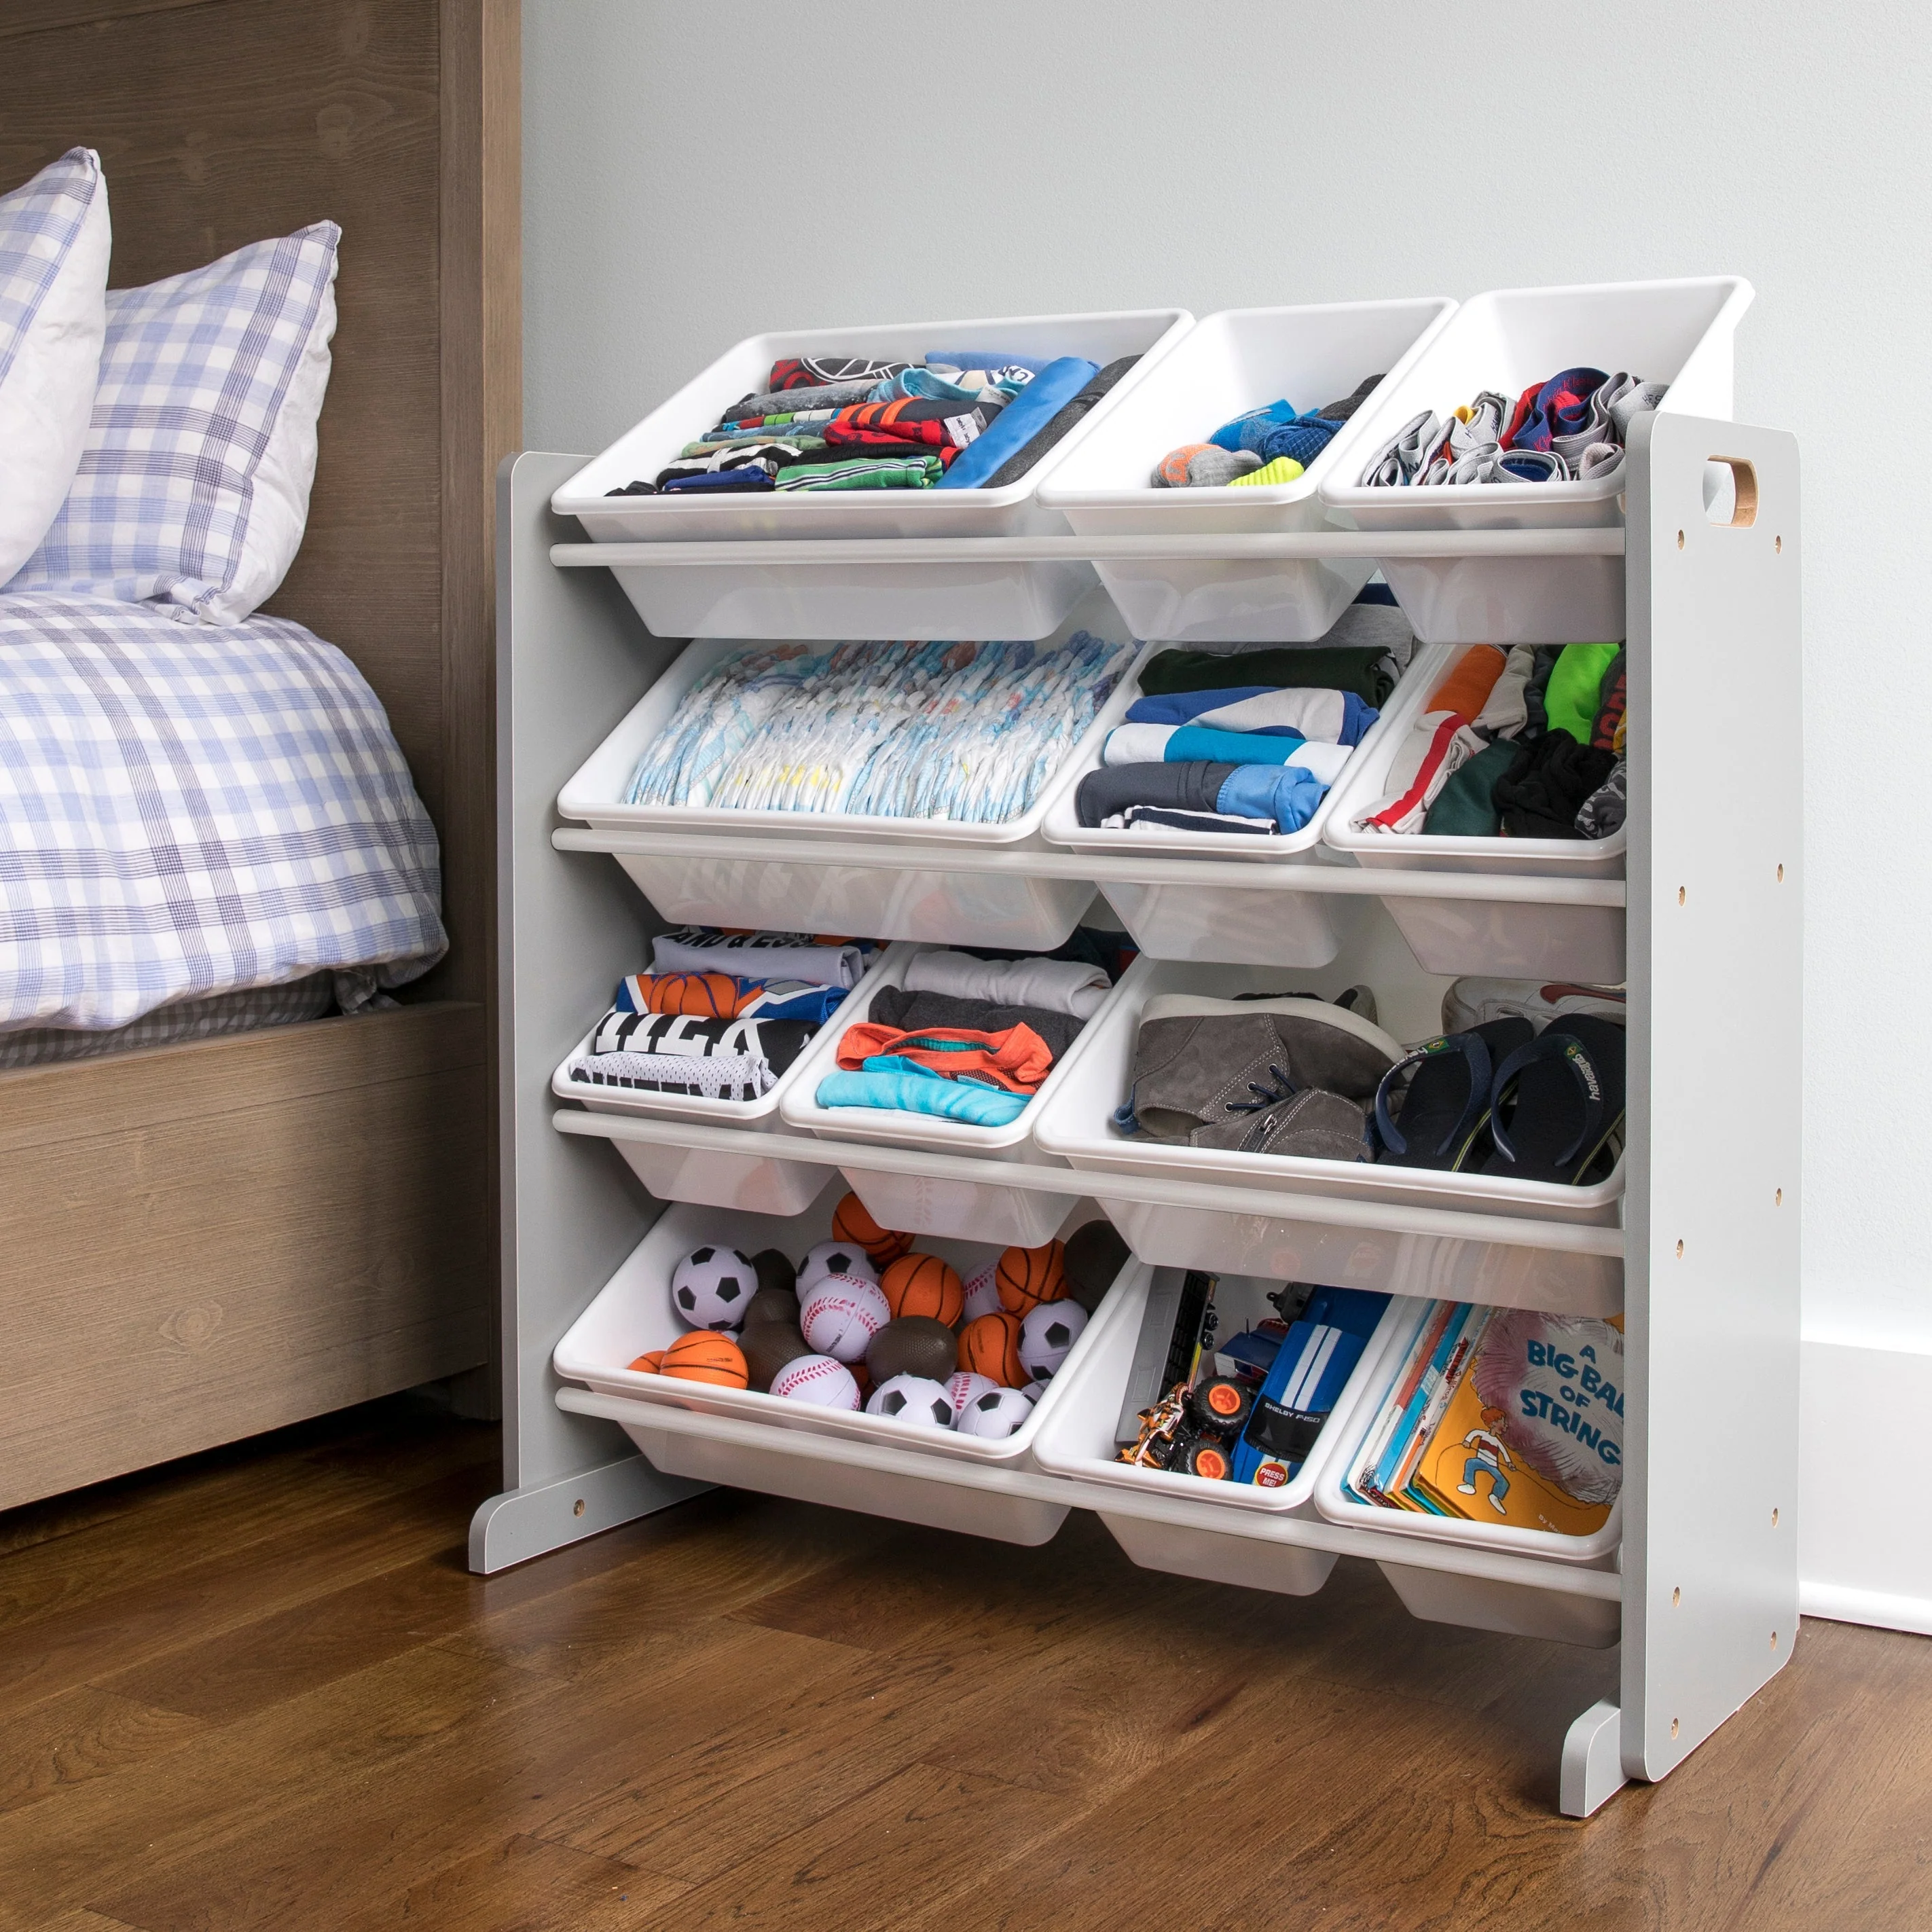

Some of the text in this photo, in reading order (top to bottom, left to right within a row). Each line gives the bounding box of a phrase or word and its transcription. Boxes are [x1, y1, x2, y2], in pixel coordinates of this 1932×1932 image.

[1528, 1339, 1579, 1379] BIG
[1579, 1345, 1596, 1364] A
[1560, 1385, 1590, 1408] OF
[1264, 1402, 1294, 1417] SHELBY
[1520, 1389, 1621, 1465] STRING
[1260, 1468, 1285, 1481] PRESS
[1262, 1478, 1277, 1487] ME!
